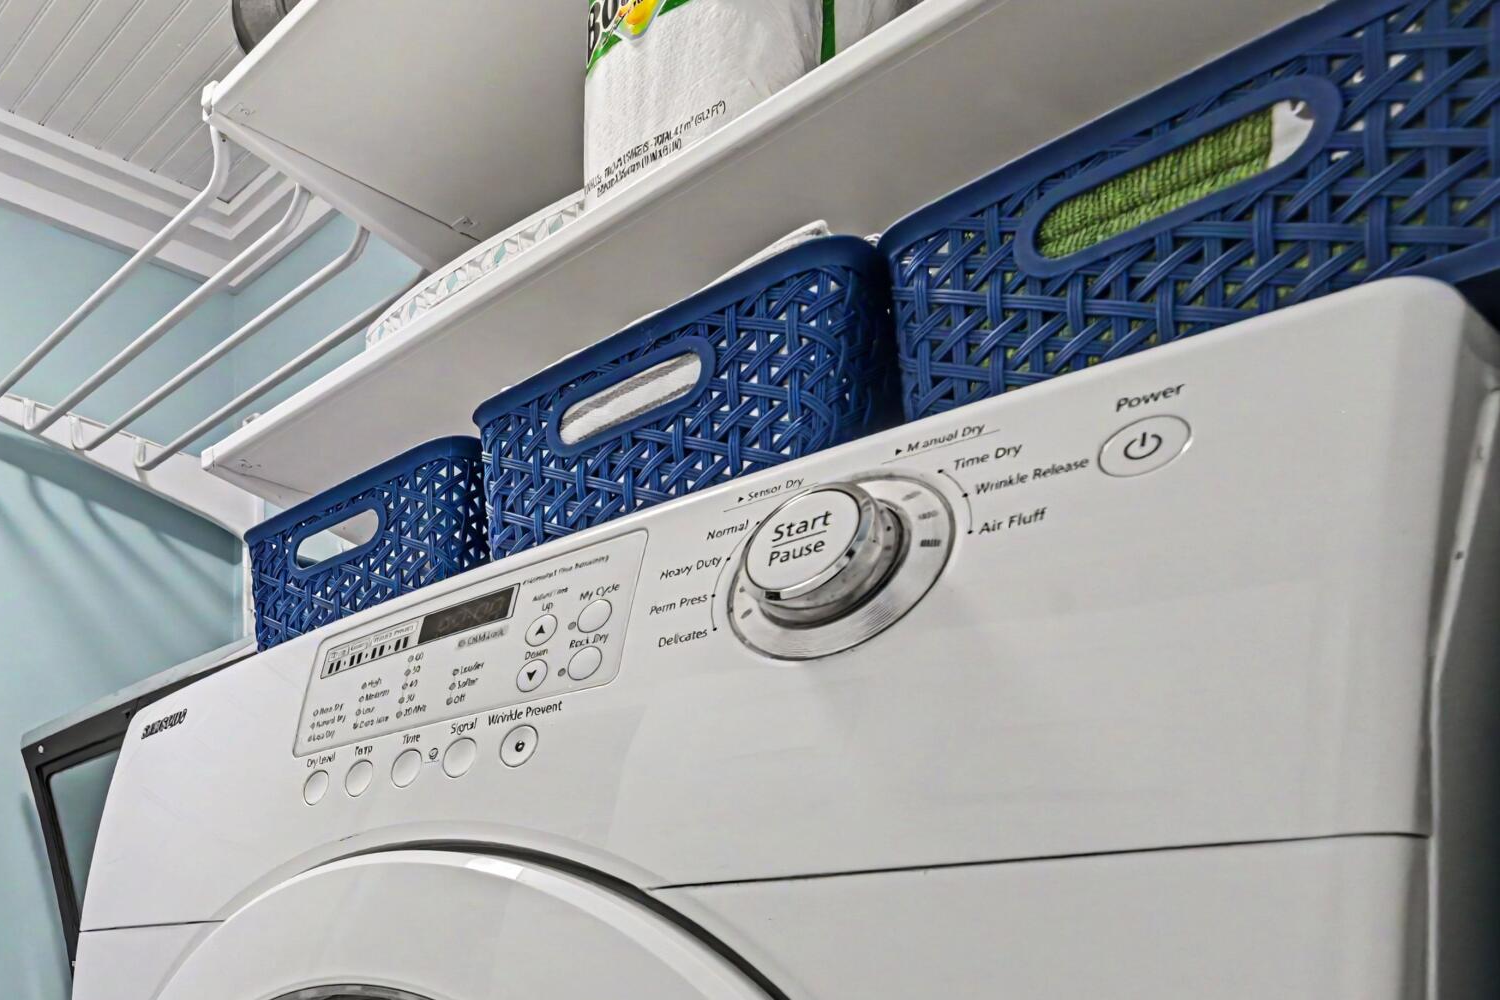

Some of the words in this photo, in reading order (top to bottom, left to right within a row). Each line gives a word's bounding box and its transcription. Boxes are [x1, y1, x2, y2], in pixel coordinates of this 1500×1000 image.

[1116, 383, 1186, 413] Power
[907, 430, 959, 452] Manual
[961, 424, 985, 439] Dry
[953, 452, 990, 471] Time
[994, 444, 1023, 460] Dry
[748, 485, 782, 501] Sensor
[785, 478, 805, 489] Dry
[975, 472, 1028, 496] Wrinkle
[1032, 457, 1090, 480] Release
[706, 519, 749, 540] Normal
[772, 510, 833, 543] Start
[978, 520, 1004, 535] Air
[1007, 506, 1048, 529] Fluff
[768, 540, 825, 567] Pause
[660, 564, 693, 580] Heavy
[696, 555, 722, 570] Duty
[579, 590, 594, 601] My
[596, 583, 621, 597] Cycle
[649, 600, 676, 616] Perm
[679, 593, 708, 608] Press
[658, 628, 708, 648] Delicates
[488, 708, 523, 726] Wrinkle
[525, 700, 563, 718] Prevent
